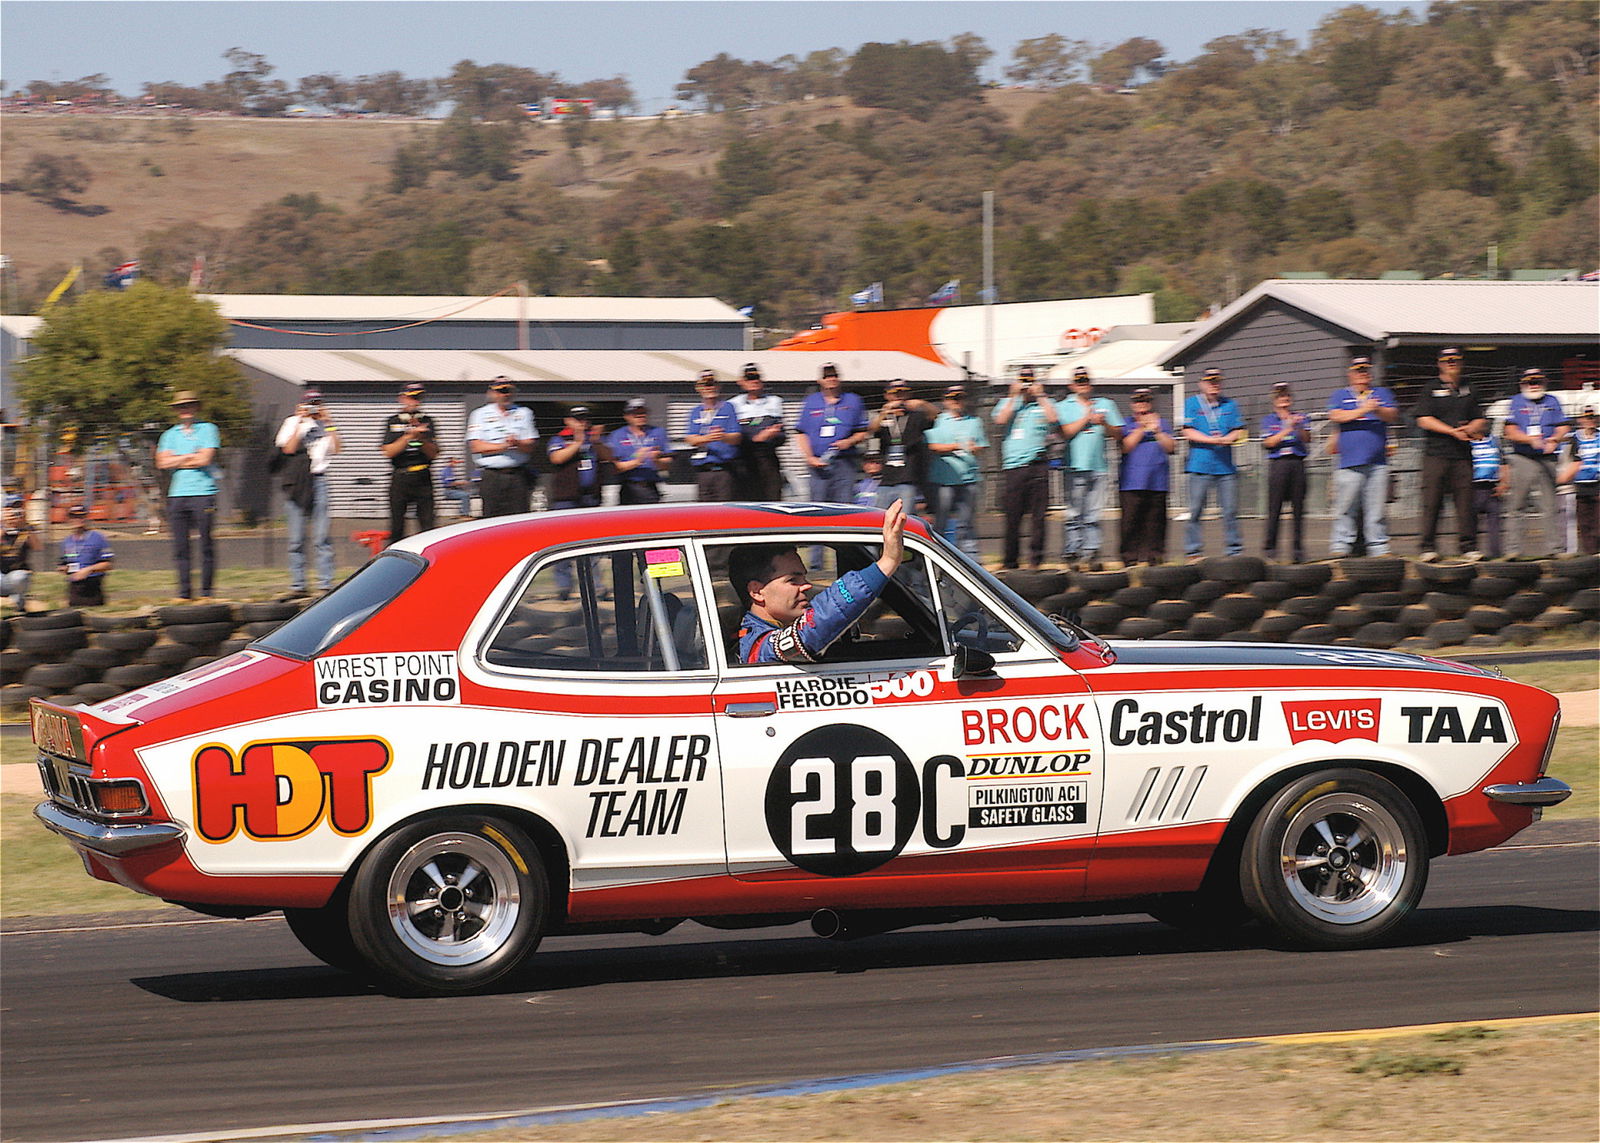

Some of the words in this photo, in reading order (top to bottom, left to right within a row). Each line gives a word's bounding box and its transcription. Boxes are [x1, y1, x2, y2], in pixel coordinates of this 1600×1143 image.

[317, 657, 388, 679] WREST
[395, 655, 454, 676] POINT
[320, 678, 456, 705] CASINO
[869, 671, 934, 699] 500
[779, 690, 869, 709] FERODO
[962, 703, 1089, 746] BROCK
[1110, 696, 1262, 746] Castrol
[1401, 707, 1507, 743] TAA
[421, 739, 566, 790] HOLDEN
[574, 734, 711, 786] DEALER
[967, 754, 1091, 776] DUNLOP
[192, 735, 393, 843] HDT
[976, 787, 1054, 805] PILKINGTON
[1058, 786, 1080, 801] ACI
[585, 788, 688, 838] TEAM
[981, 807, 1028, 825] SAFETY
[1032, 805, 1074, 822] GLASS
